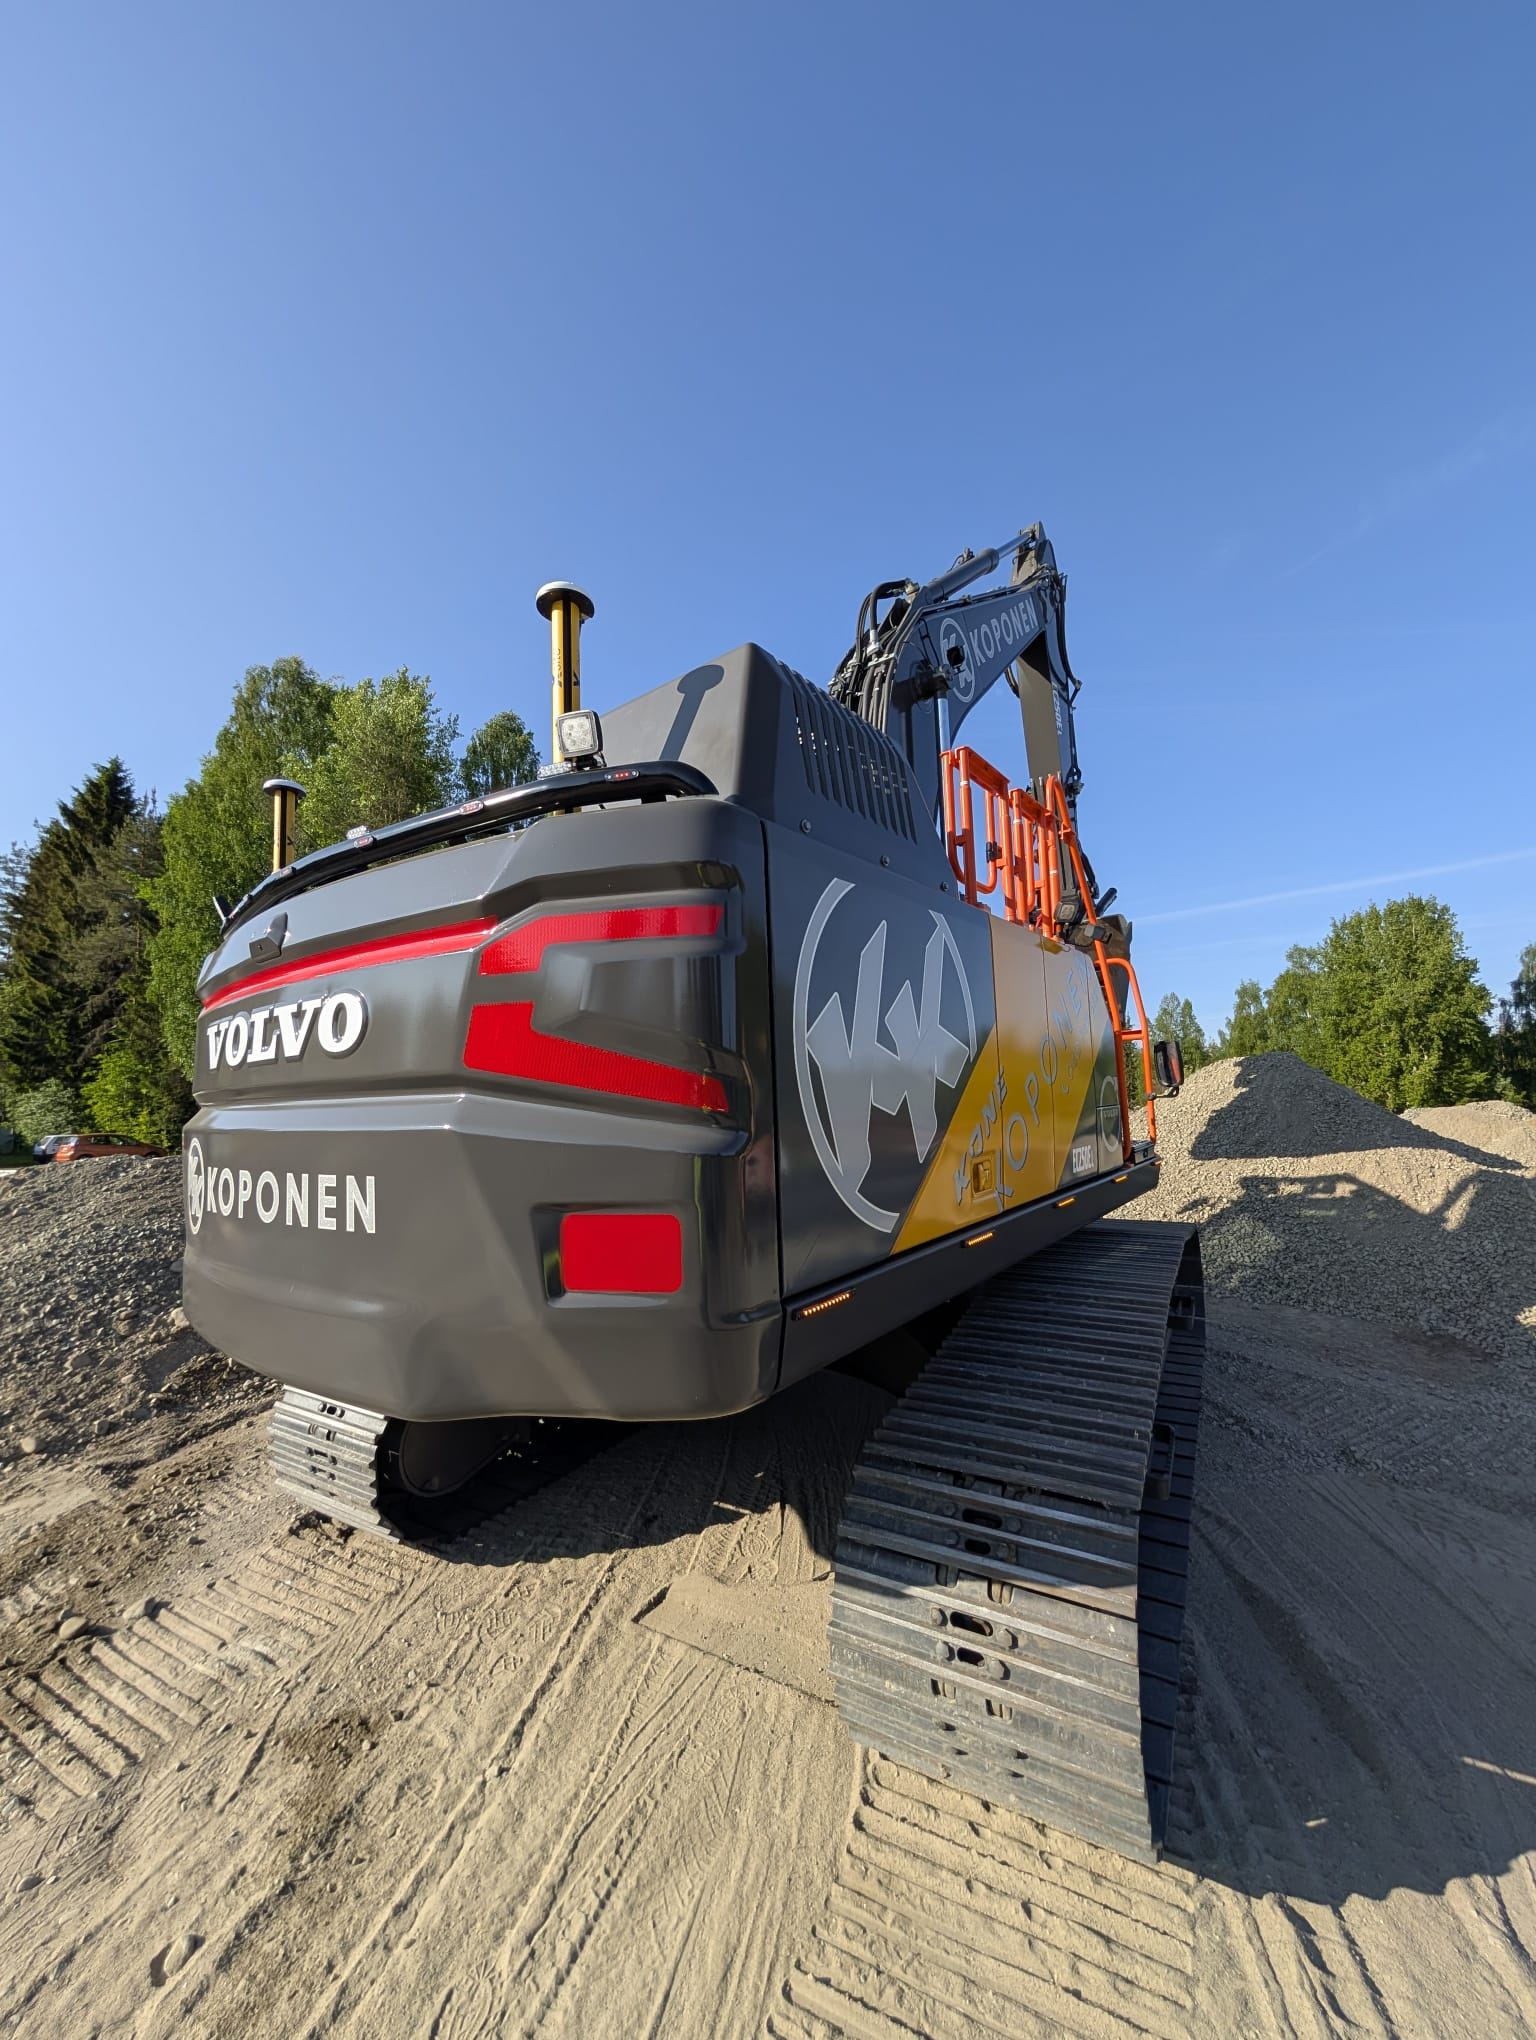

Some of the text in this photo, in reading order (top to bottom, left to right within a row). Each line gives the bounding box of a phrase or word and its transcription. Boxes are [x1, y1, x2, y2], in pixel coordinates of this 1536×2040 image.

[969, 596, 1039, 666] KOPONEN
[206, 990, 366, 1070] VOLVO
[206, 1166, 376, 1234] KOPONEN
